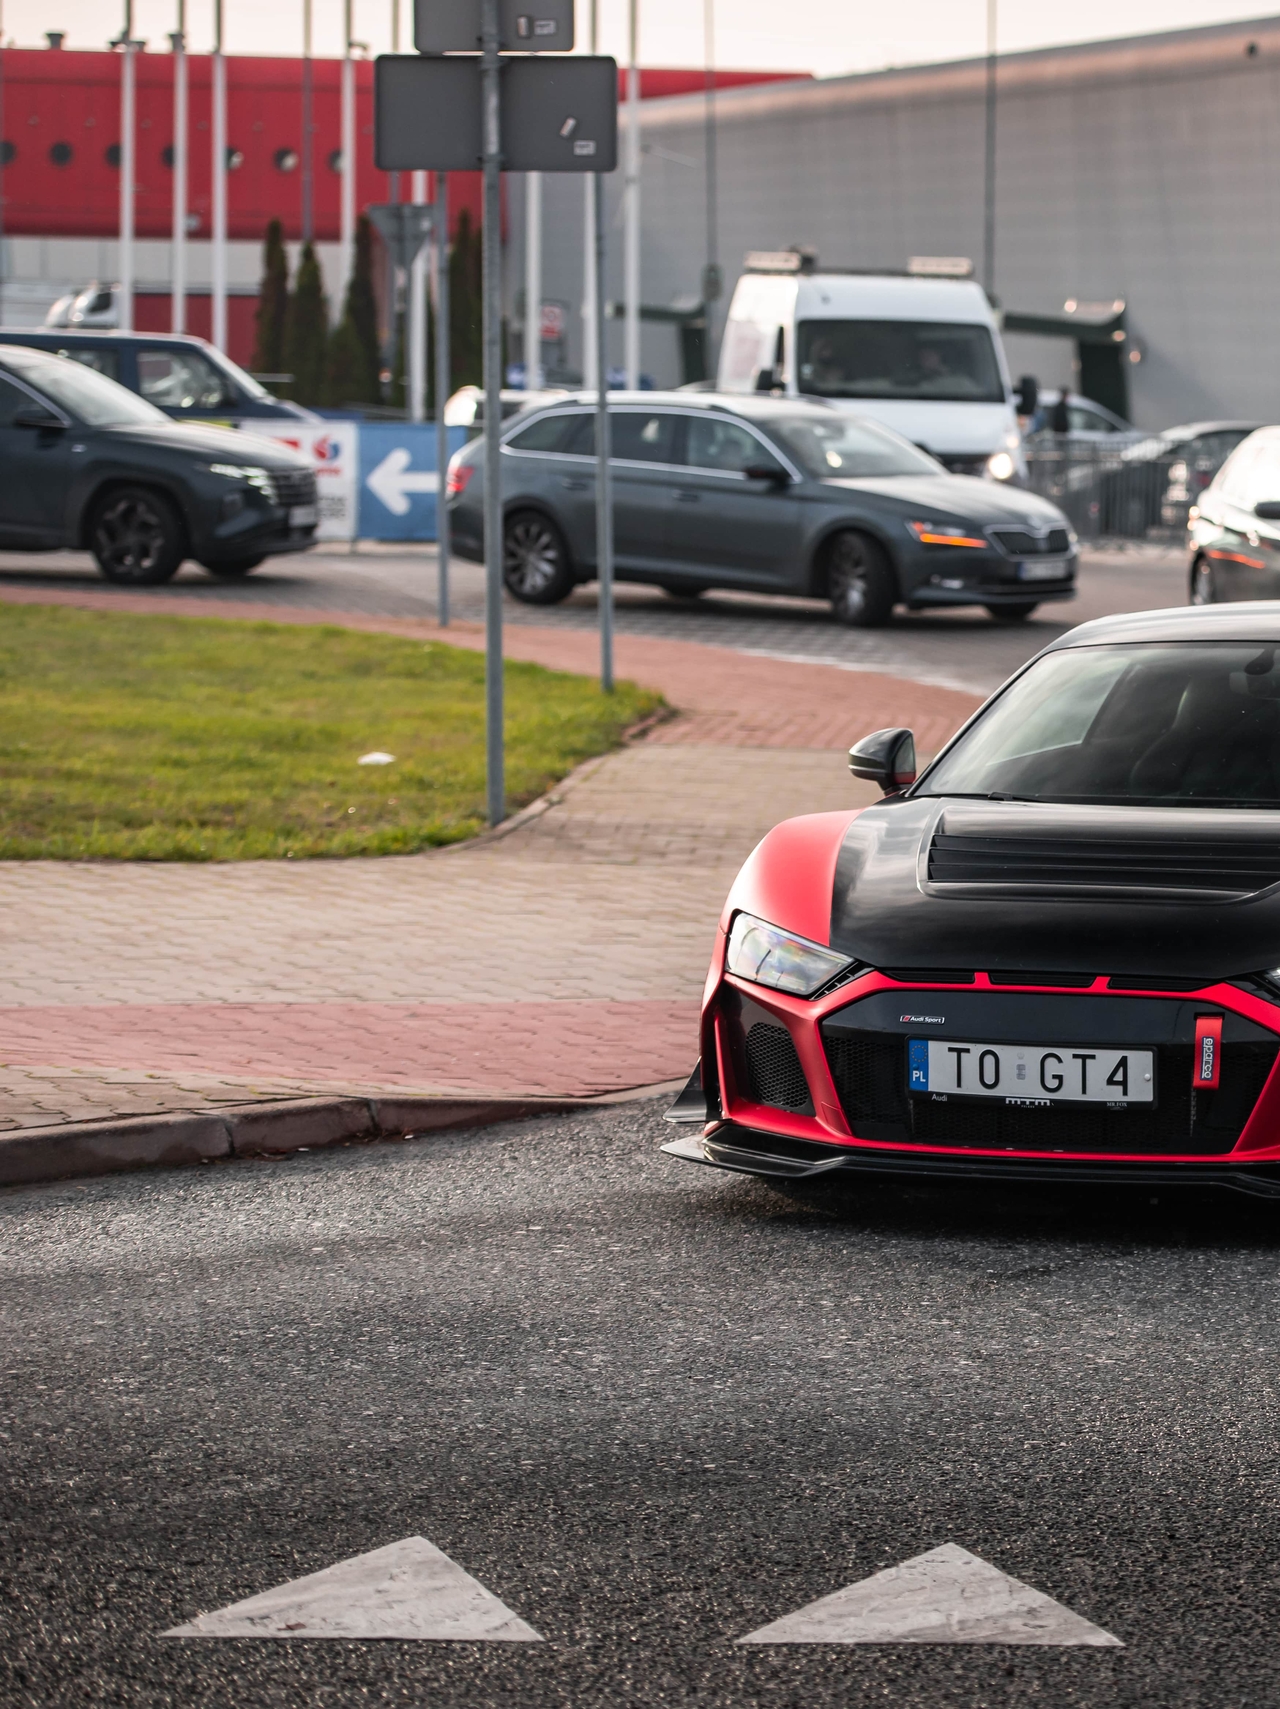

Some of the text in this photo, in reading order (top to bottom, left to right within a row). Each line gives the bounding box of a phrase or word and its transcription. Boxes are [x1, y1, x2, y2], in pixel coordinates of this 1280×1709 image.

[912, 1070, 926, 1082] PL
[1040, 1052, 1128, 1096] GT4
[931, 1093, 948, 1102] Audi
